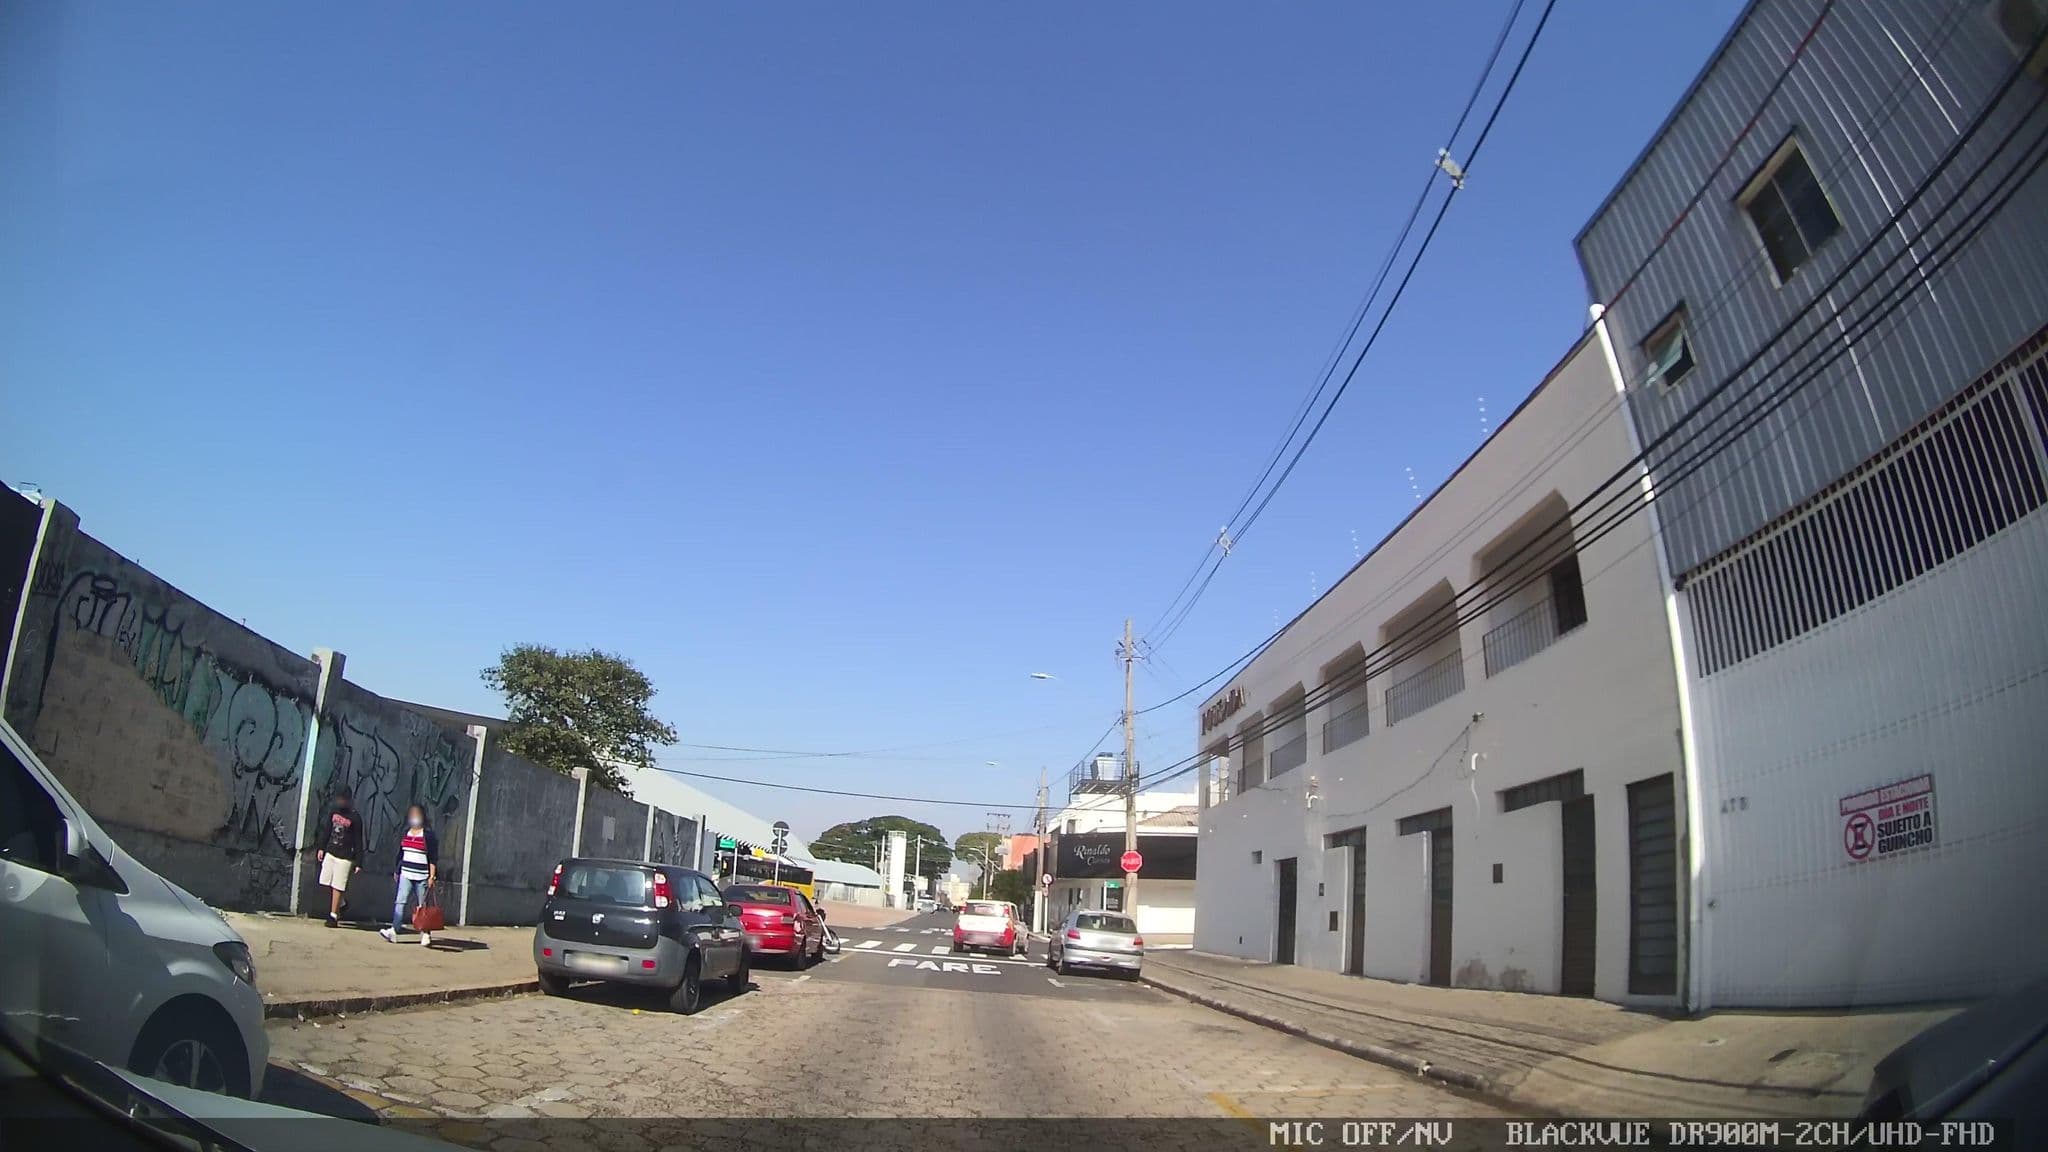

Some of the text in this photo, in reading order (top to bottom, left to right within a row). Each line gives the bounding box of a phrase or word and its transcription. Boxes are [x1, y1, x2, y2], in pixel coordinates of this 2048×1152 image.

[1878, 797, 1929, 820] DIA E NOITE
[1877, 811, 1932, 838] SUJEITO A
[1878, 827, 1933, 853] GUINCHO
[887, 957, 1002, 975] PARE
